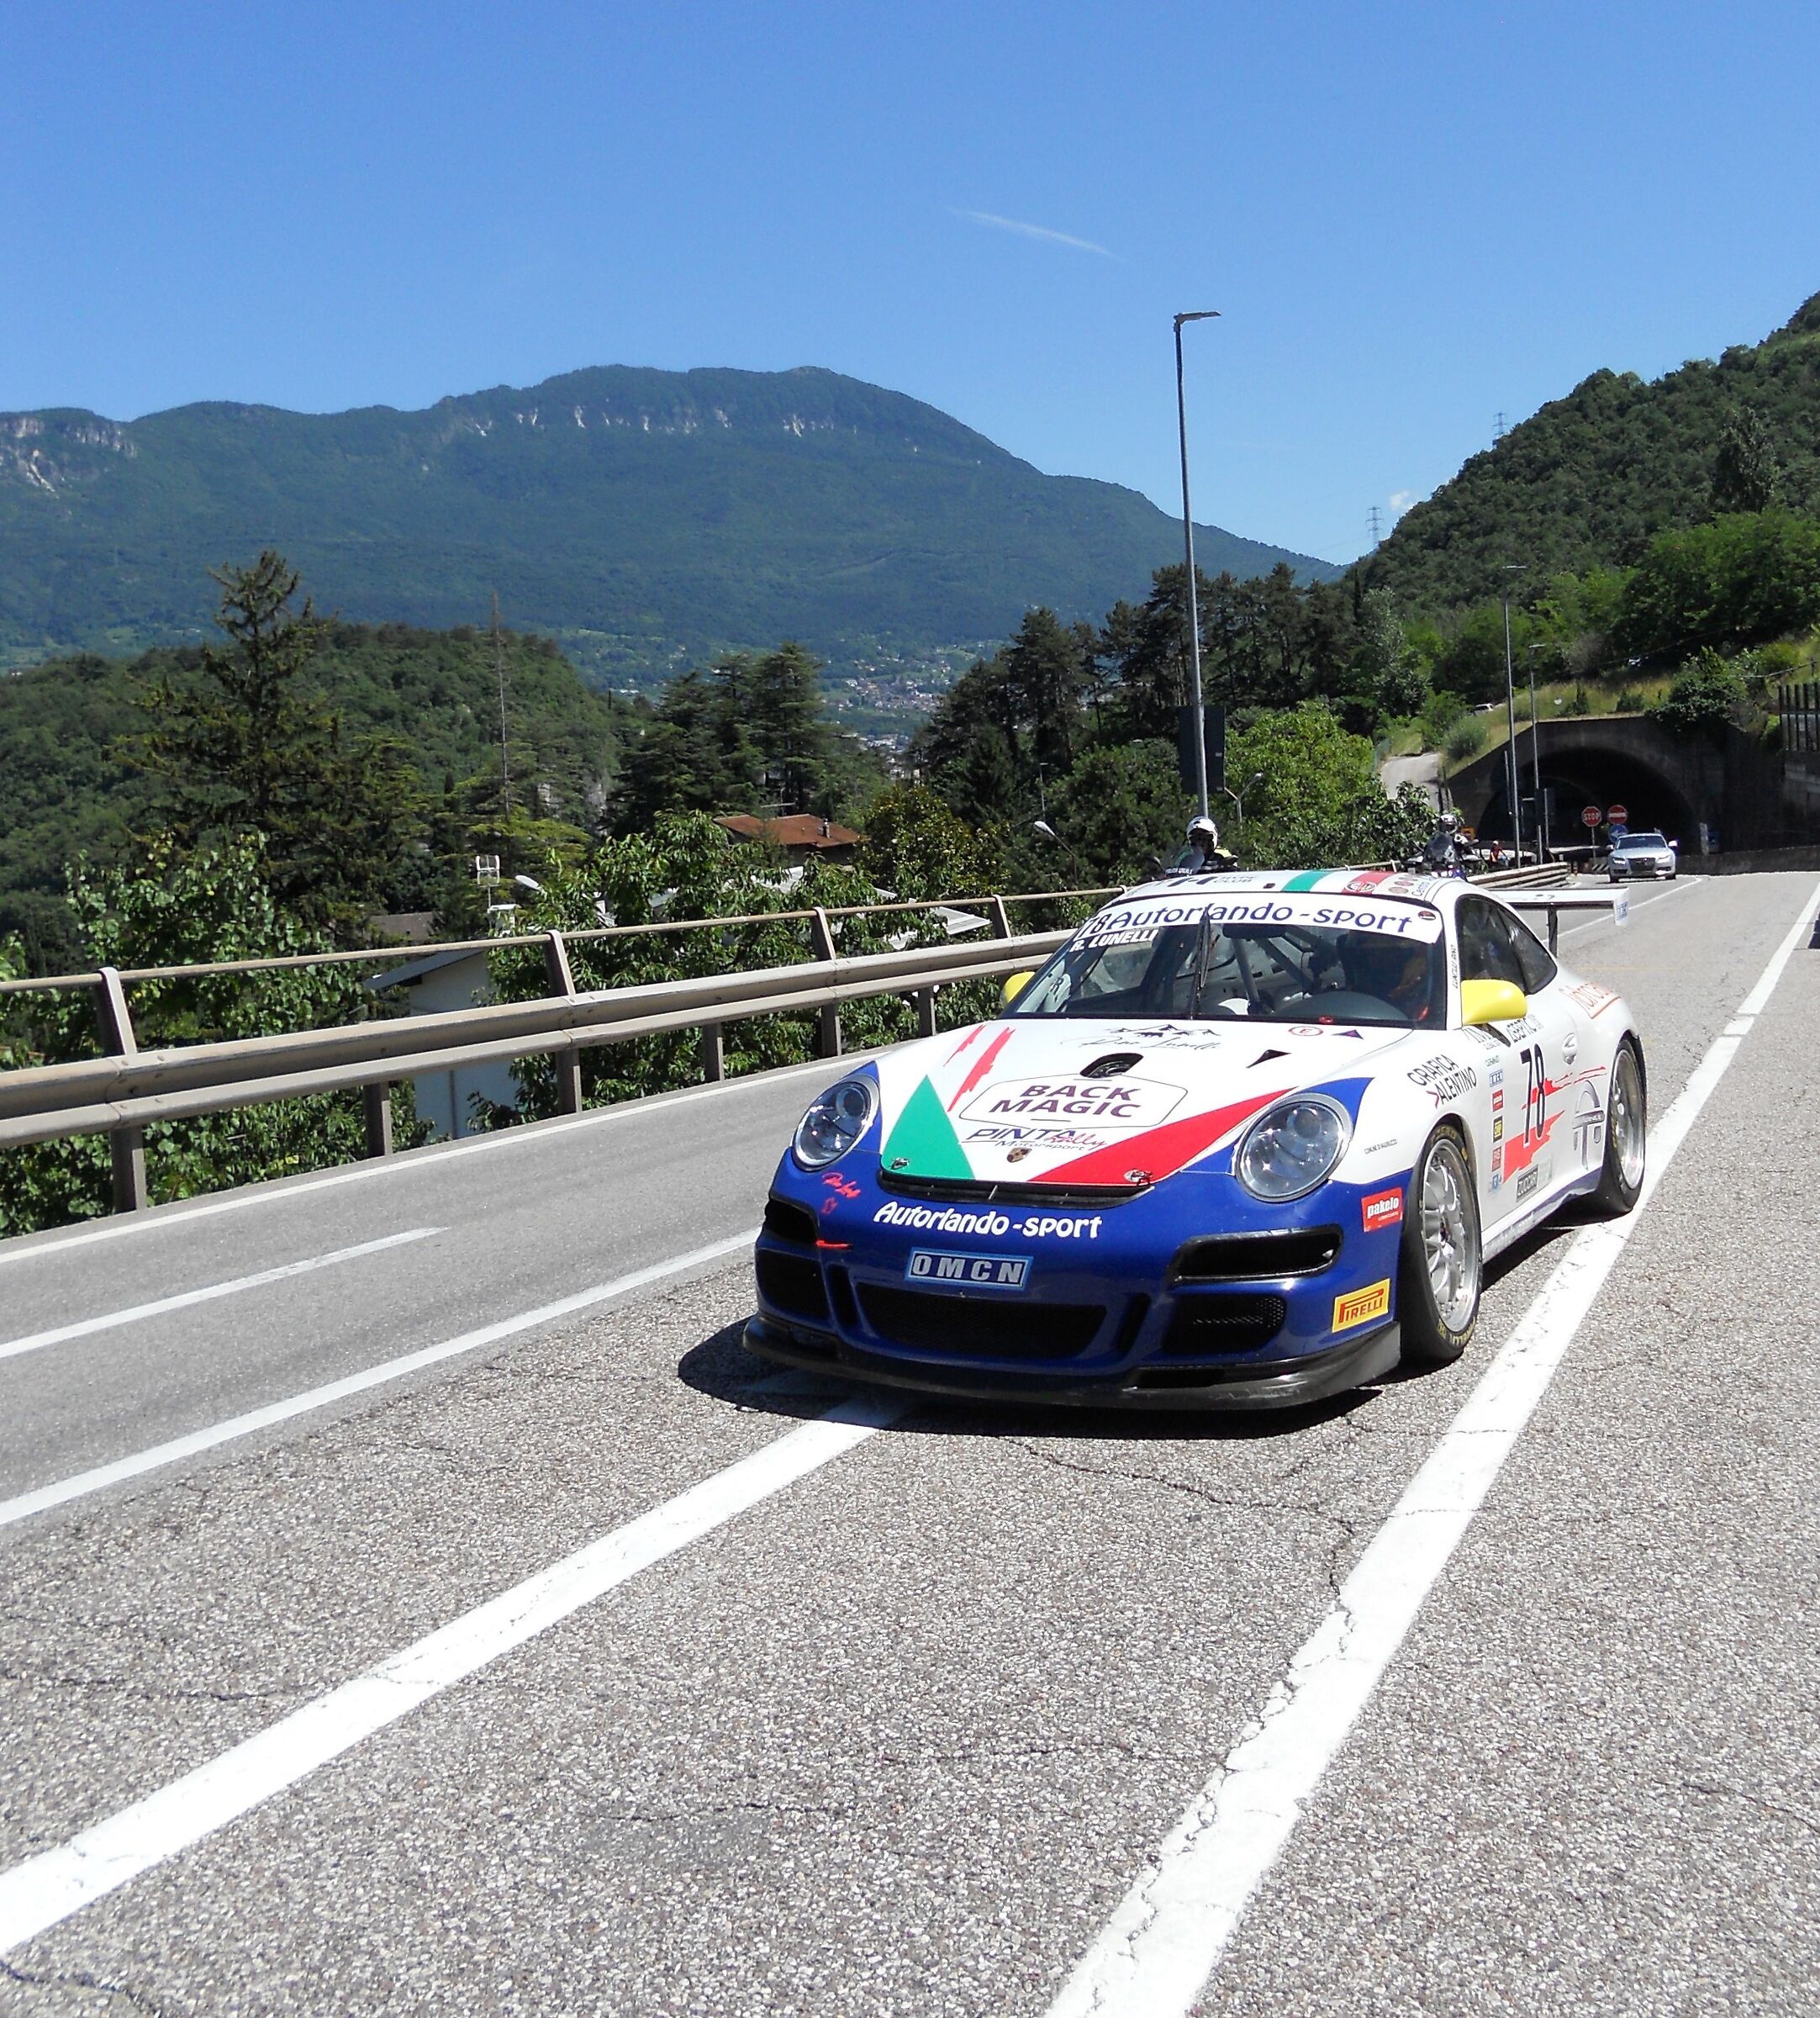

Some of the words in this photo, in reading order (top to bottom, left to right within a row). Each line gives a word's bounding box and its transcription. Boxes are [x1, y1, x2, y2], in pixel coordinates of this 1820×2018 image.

[1583, 811, 1600, 821] STOP
[1069, 938, 1085, 953] R.
[1088, 929, 1159, 948] LUNELLI
[1406, 1054, 1459, 1086] GRAFICA
[1019, 1085, 1142, 1101] BACK
[1520, 1043, 1546, 1144] 78
[989, 1100, 1142, 1118] MAGIC
[966, 1128, 1076, 1141] PINTA
[994, 1139, 1086, 1151] Motorsport
[1367, 1197, 1400, 1219] pakelo
[911, 1255, 1023, 1283] OMCN
[1338, 1288, 1385, 1323] PIRELLI
